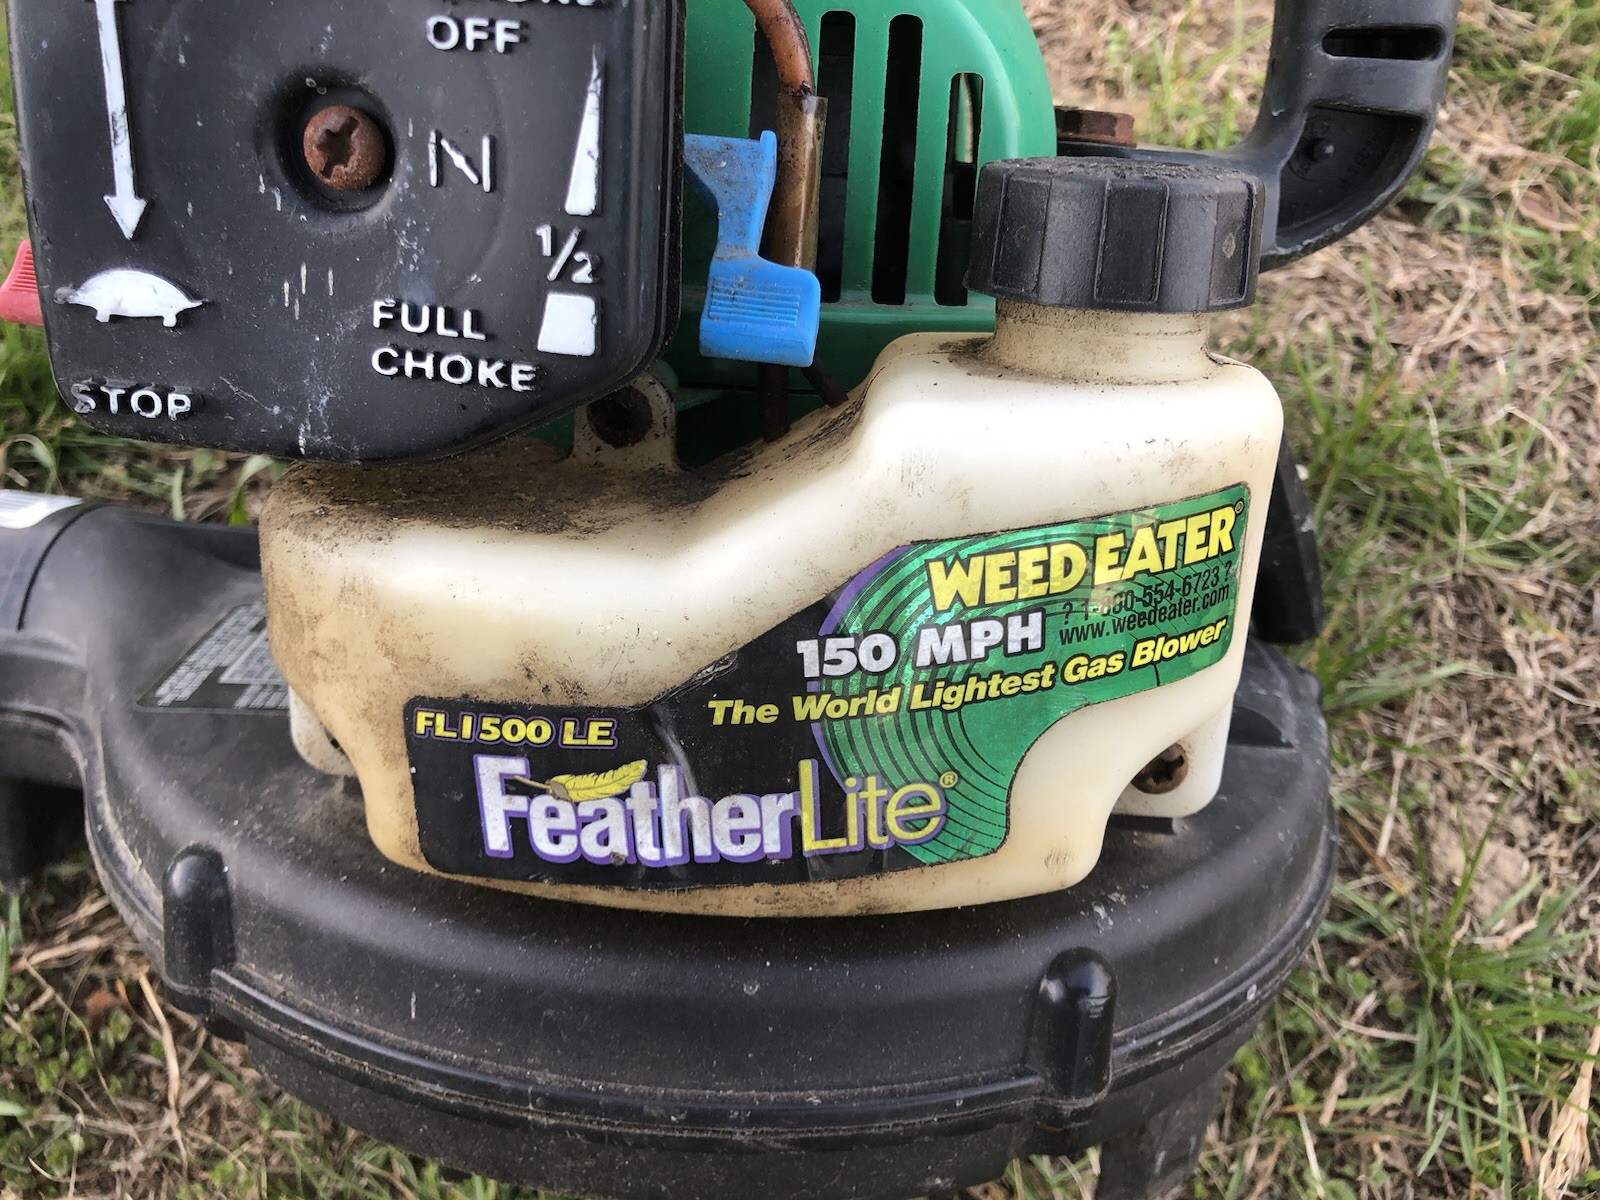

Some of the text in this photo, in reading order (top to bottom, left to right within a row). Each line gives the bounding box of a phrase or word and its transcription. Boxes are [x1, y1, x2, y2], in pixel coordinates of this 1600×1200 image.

[425, 14, 521, 54] OFF
[372, 299, 487, 342] FULL
[370, 347, 536, 392] CHOKE
[70, 382, 192, 422] STOP
[926, 542, 1088, 611] WEED
[1058, 584, 1230, 645] www.weedeater.com
[796, 611, 1043, 678] 150 MPH
[707, 617, 1227, 727] The World Lightest Gas Blower
[562, 720, 615, 747] LE
